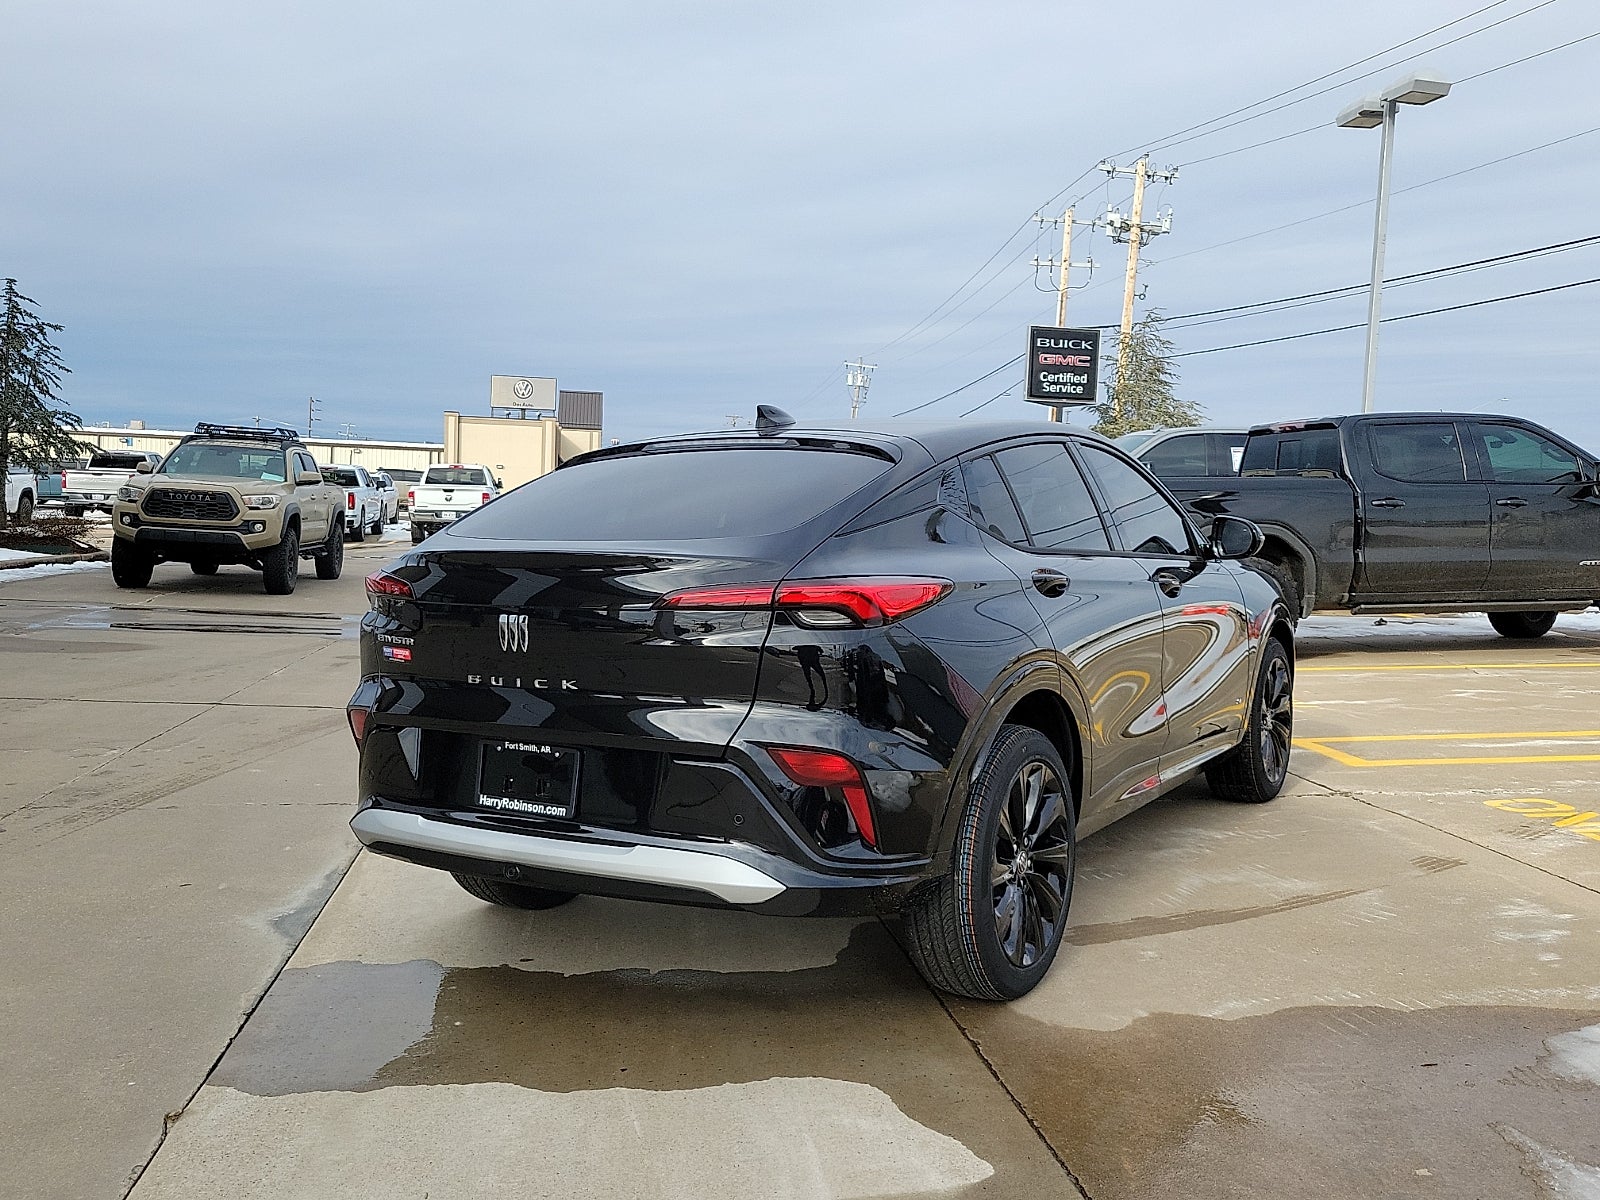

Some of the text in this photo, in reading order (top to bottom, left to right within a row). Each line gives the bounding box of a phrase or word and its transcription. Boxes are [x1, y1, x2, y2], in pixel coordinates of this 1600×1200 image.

[1036, 338, 1093, 350] BUICK
[1039, 353, 1091, 367] GMC
[1040, 371, 1088, 384] Certified
[1042, 382, 1083, 394] Service
[168, 492, 211, 502] TOYOTA
[466, 674, 579, 690] BUICK
[505, 741, 551, 754] Fort Smith, AR
[479, 793, 567, 817] HarryRobinson.com
